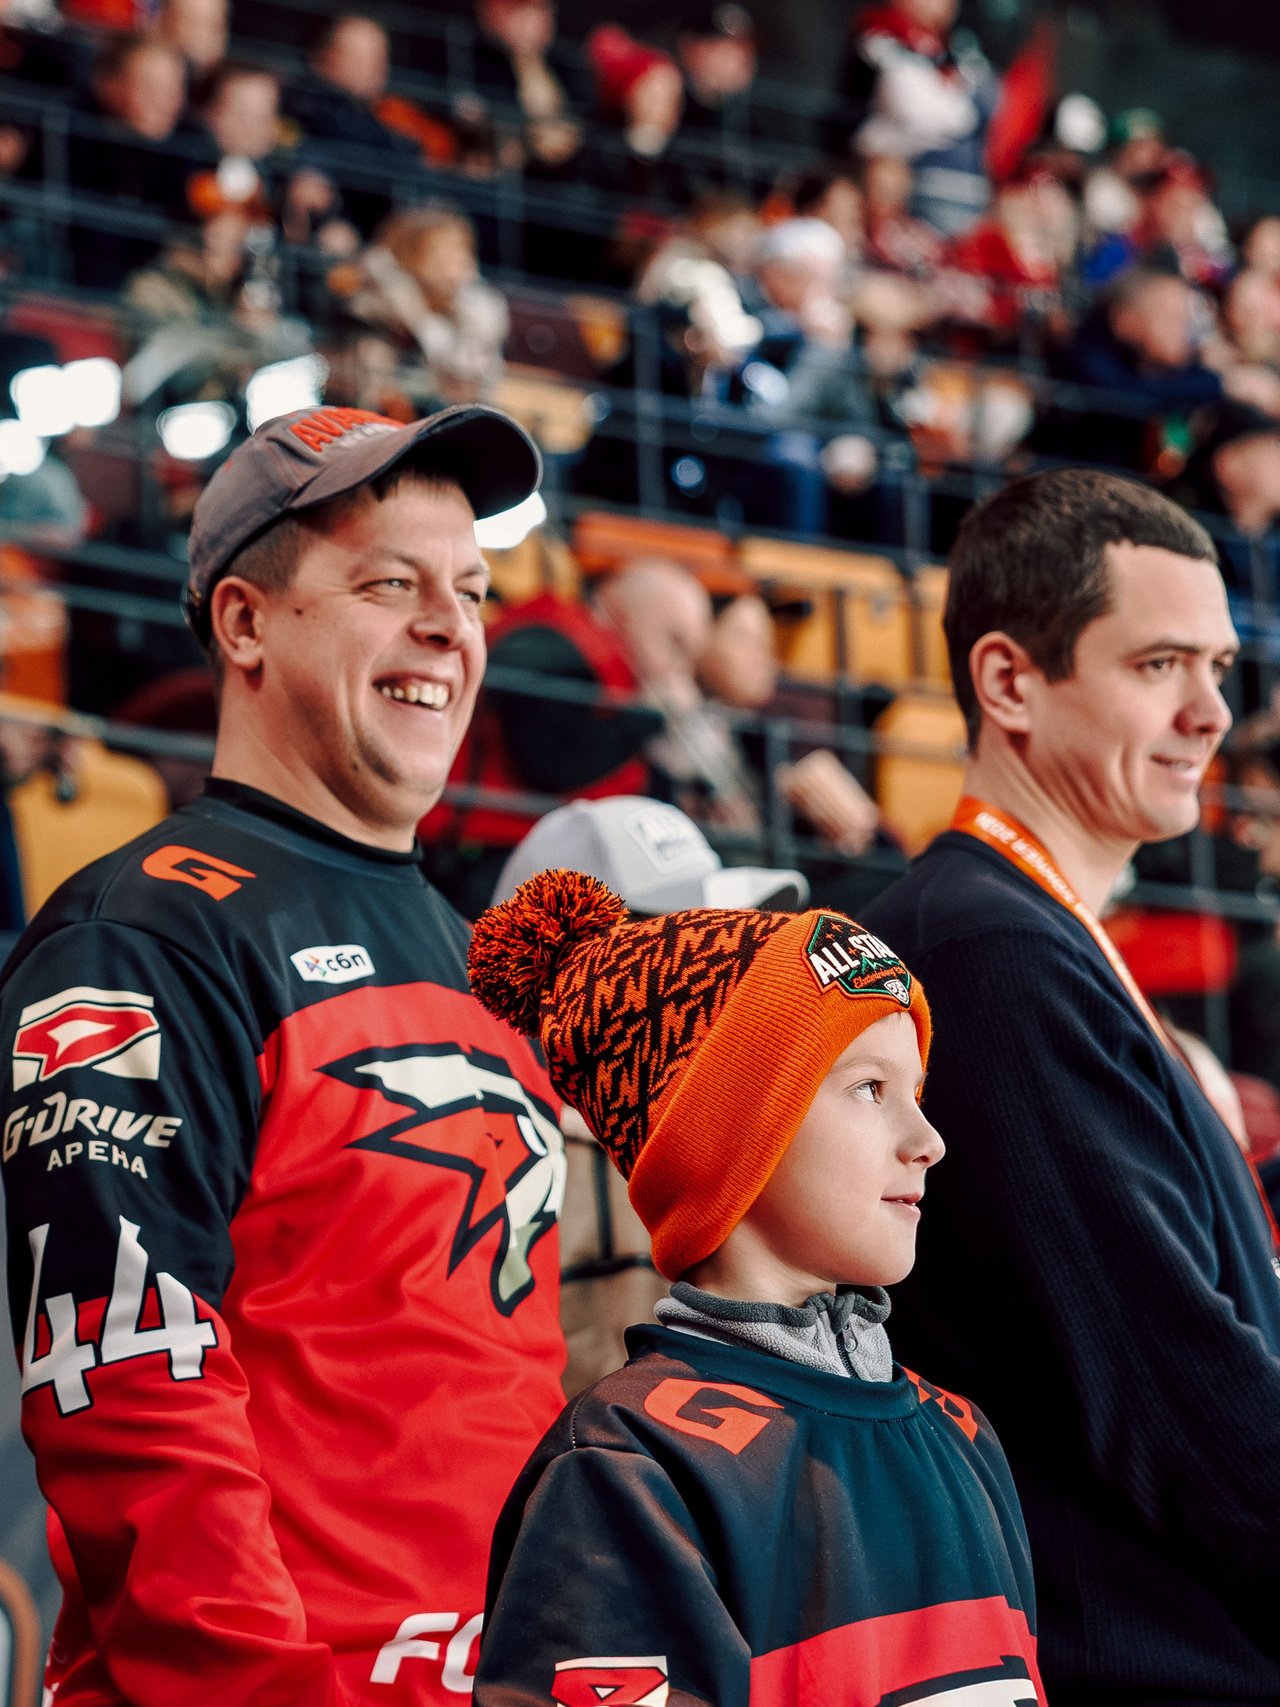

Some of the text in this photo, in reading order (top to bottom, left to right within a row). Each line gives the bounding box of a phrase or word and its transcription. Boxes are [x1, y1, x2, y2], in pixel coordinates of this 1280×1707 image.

[142, 844, 258, 901] G
[325, 952, 367, 971] сбп
[809, 941, 861, 985] ALL
[46, 1140, 149, 1179] АРЕНА
[22, 1214, 218, 1416] 44
[643, 1377, 785, 1455] G
